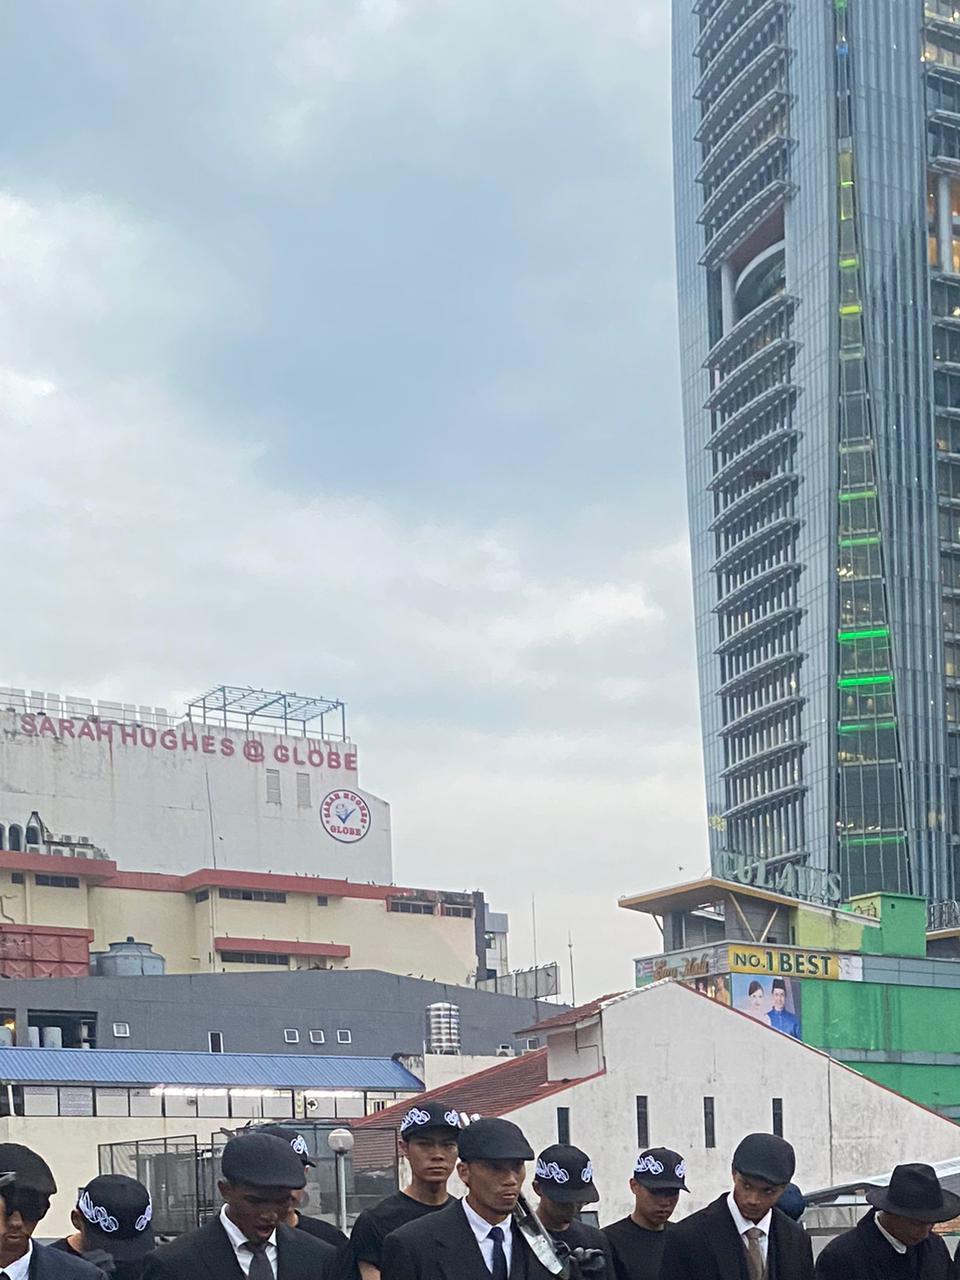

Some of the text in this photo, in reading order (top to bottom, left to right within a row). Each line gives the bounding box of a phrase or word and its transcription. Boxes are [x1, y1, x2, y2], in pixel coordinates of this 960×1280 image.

[21, 713, 357, 771] SARAH HUGHES @ GLOBE
[324, 793, 341, 818] SARAH
[330, 825, 361, 836] GLOBE
[780, 952, 831, 976] BEST
